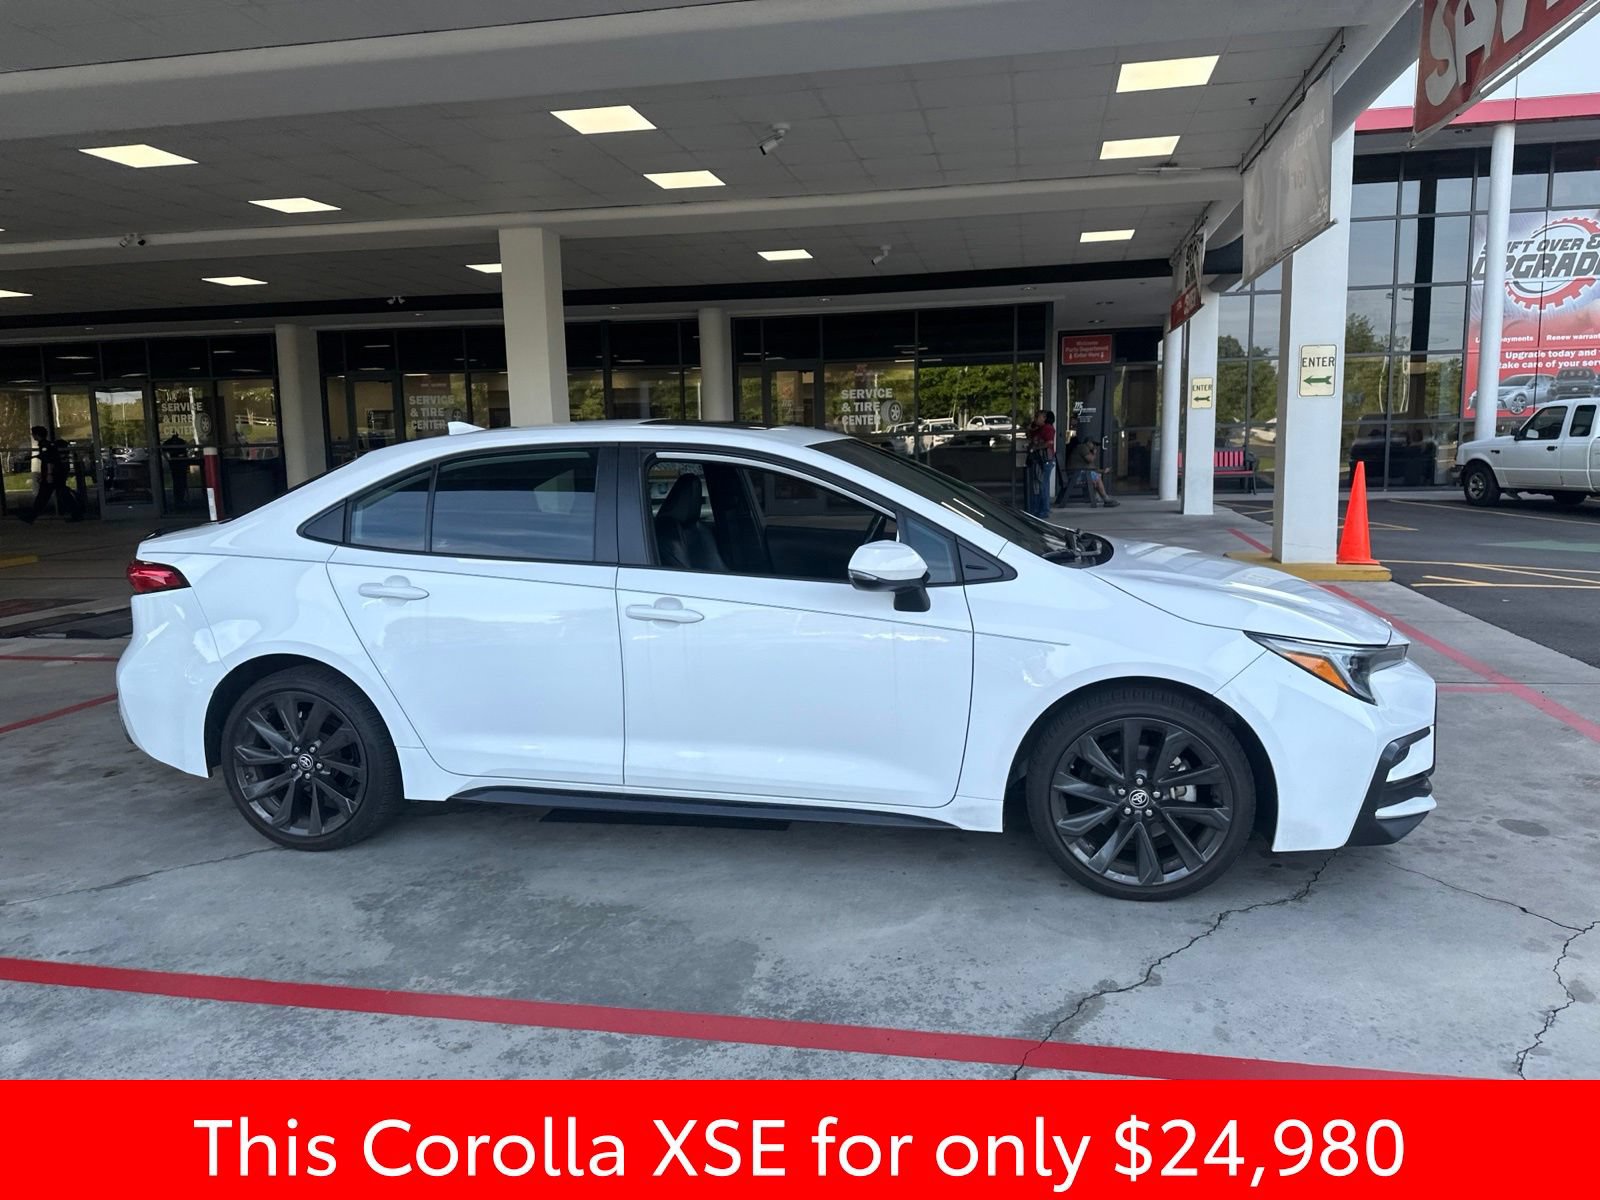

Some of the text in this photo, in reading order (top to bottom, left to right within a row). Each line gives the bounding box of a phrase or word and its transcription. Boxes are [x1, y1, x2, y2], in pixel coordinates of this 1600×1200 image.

[1425, 0, 1561, 106] SA
[1536, 238, 1585, 252] OVER
[1472, 251, 1600, 281] GRAD
[1501, 335, 1534, 344] ayments
[1505, 350, 1546, 360] Upgrade
[1548, 350, 1577, 359] today
[1577, 348, 1598, 357] and
[1302, 356, 1336, 368] ENTER
[1521, 360, 1544, 369] care
[1545, 360, 1557, 368] of
[1558, 360, 1581, 369] your
[841, 387, 893, 400] SERVICE
[1192, 384, 1213, 392] ENTER
[408, 395, 455, 405] SERVICE
[161, 402, 203, 412] SERVICE
[410, 407, 446, 418] & TIRE
[841, 401, 881, 413] & TIRE
[411, 420, 447, 431] CENTER
[841, 414, 881, 426] CENTER
